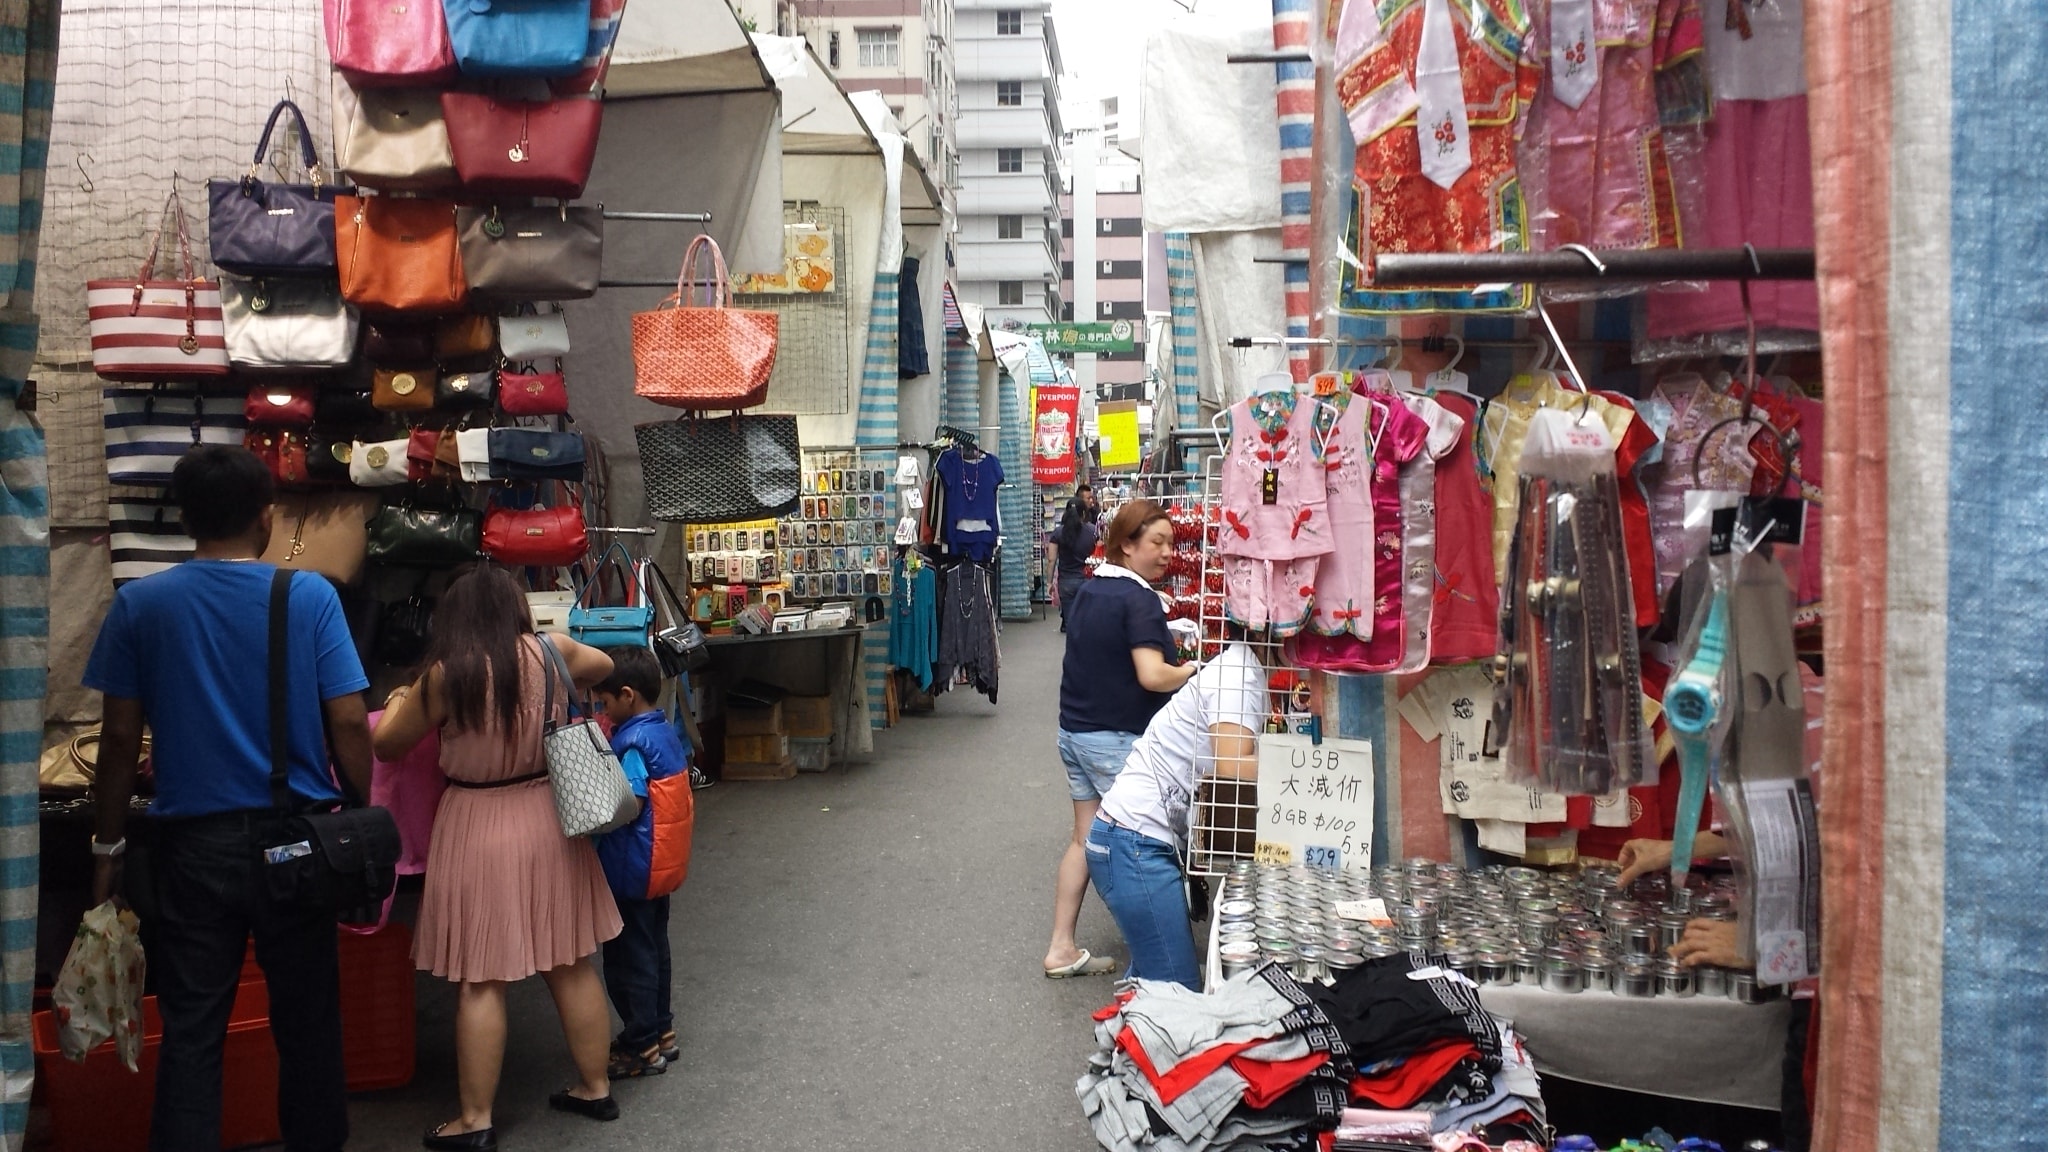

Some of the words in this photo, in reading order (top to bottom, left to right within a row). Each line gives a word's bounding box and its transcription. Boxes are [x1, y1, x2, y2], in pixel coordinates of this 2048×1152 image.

[1291, 748, 1339, 771] USB
[1313, 812, 1356, 832] $100
[1305, 846, 1336, 866] $29
